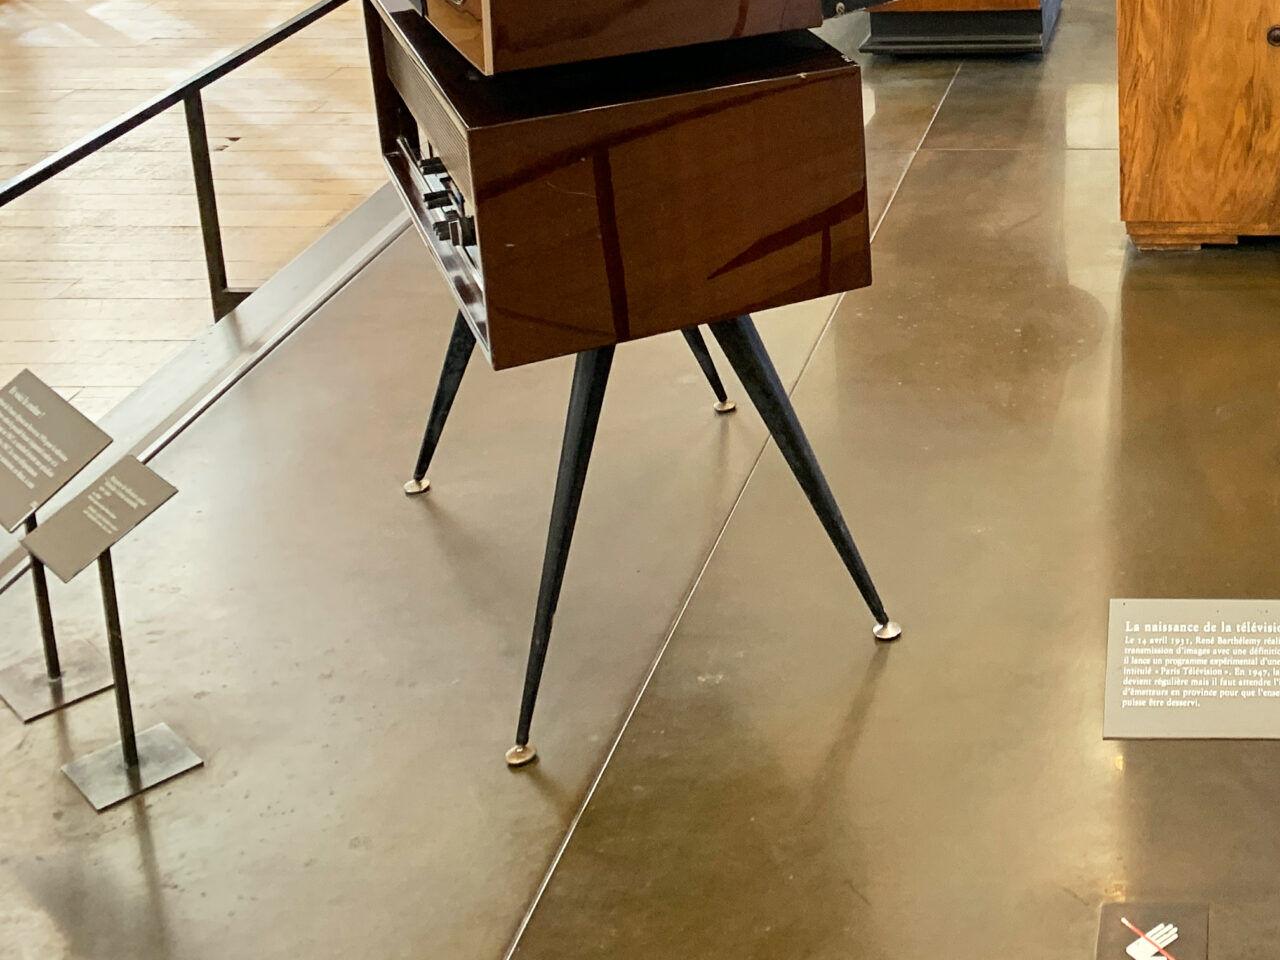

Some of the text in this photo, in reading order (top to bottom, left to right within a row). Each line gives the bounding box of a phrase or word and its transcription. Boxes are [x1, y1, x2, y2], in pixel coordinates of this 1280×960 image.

[1125, 621, 1140, 632] La
[1144, 621, 1200, 633] naissance
[1203, 621, 1217, 633] de
[1221, 621, 1232, 633] la
[1125, 636, 1135, 644] Le
[1149, 636, 1168, 644] avril
[1195, 636, 1214, 645] René
[1217, 636, 1261, 647] Barthélemy
[1124, 646, 1174, 655] transmission
[1175, 646, 1210, 656] d'images
[1232, 648, 1247, 656] une
[1131, 656, 1151, 665] lance
[1152, 657, 1163, 665] un
[1164, 657, 1208, 667] programme
[1209, 657, 1258, 667] expérimental
[1259, 657, 1280, 666] d'une
[1123, 667, 1152, 675] intitulé
[1160, 667, 1181, 675] Paris
[1182, 667, 1223, 676] Télévision
[1234, 667, 1245, 676] En
[1272, 668, 1280, 676] la
[1122, 677, 1151, 686] devient
[1154, 677, 1188, 687] régulière
[1190, 678, 1210, 686] mais
[1211, 678, 1217, 686] il
[1219, 677, 1236, 686] faut
[1238, 677, 1271, 686] attendre
[1122, 687, 1169, 696] d'émetteurs
[1182, 688, 1217, 698] province
[1219, 688, 1238, 698] pour
[1240, 689, 1255, 698] que
[1122, 697, 1201, 708] puisse être desservi.
